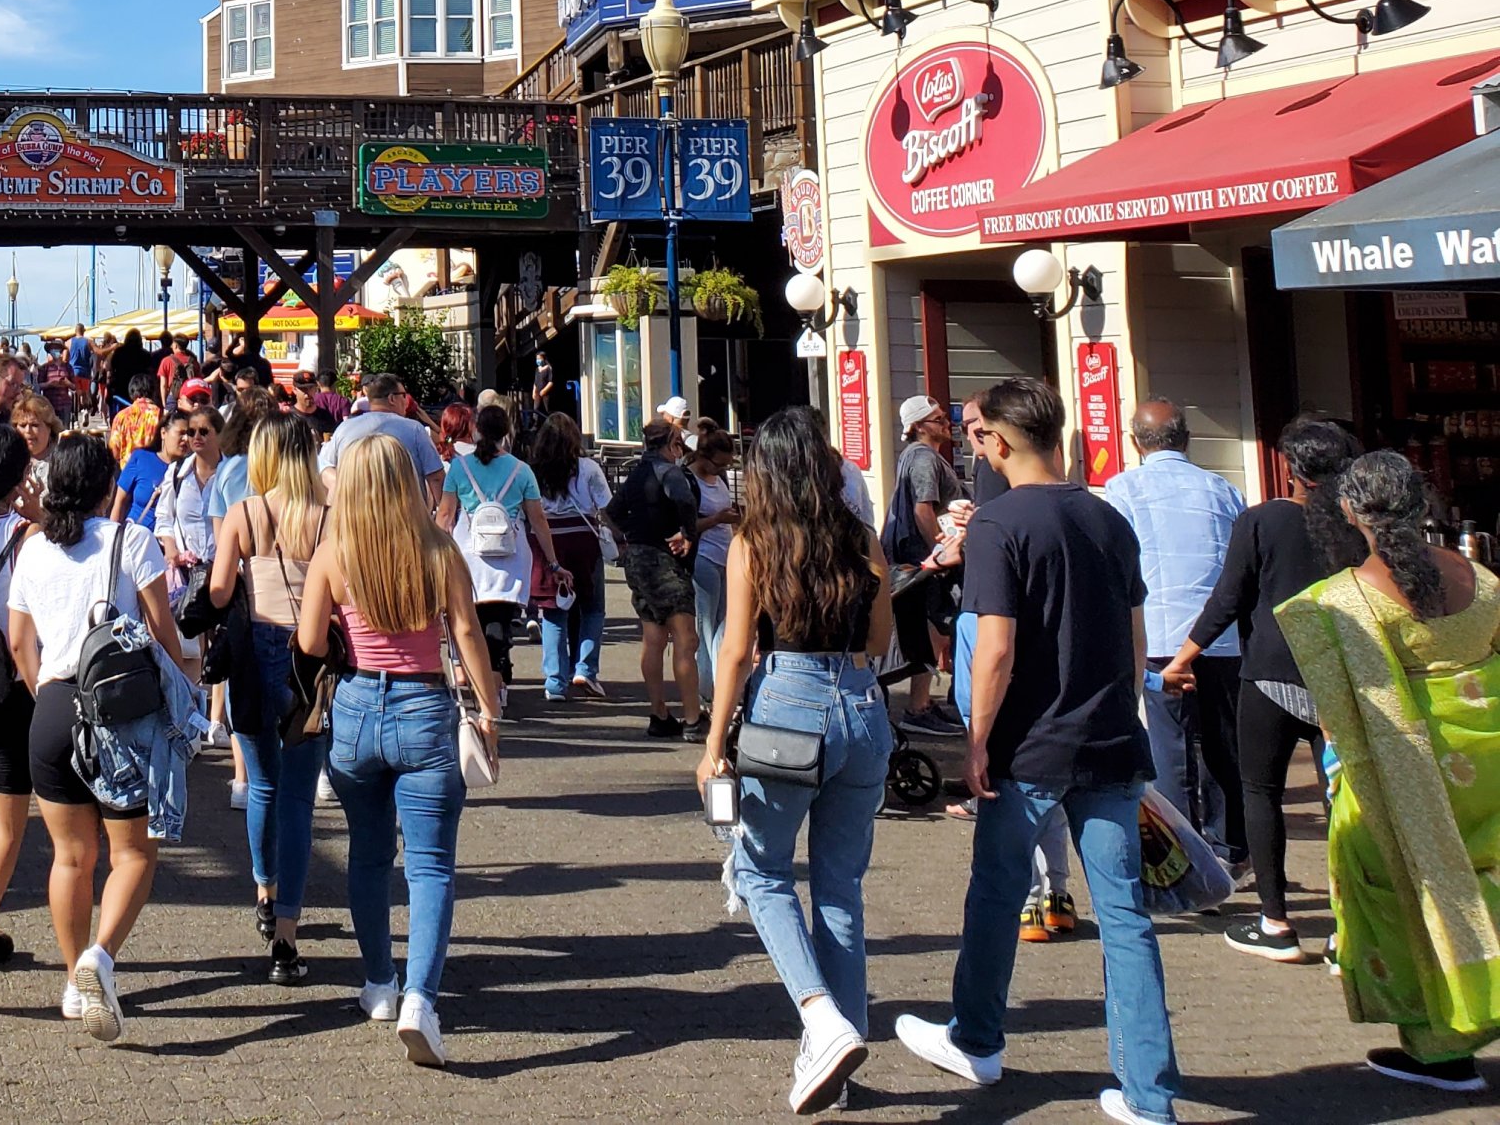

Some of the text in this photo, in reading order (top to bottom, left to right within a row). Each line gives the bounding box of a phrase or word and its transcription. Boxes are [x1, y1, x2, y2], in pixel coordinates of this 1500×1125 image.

[921, 69, 954, 104] Lotus
[2, 144, 11, 155] of
[17, 141, 63, 153] BUBBA GUMP
[600, 135, 650, 155] PIER
[688, 137, 740, 156] PIER
[902, 92, 987, 184] Biscoff
[66, 144, 106, 167] the Pier!
[48, 169, 125, 196] SHRIMP
[373, 167, 540, 194] PLAYERS
[598, 156, 653, 200] 39
[687, 157, 743, 201] 39
[430, 200, 453, 210] END
[472, 201, 491, 212] THE
[494, 202, 518, 212] PIER
[791, 182, 819, 205] BOUDIN
[911, 178, 995, 214] COFFEE CORNER
[983, 171, 1339, 235] FREE BISCOFF COOKIE SERVED WITH EVERY COFFEE
[1311, 235, 1414, 273] Whale
[272, 320, 301, 328] HOT DOGS
